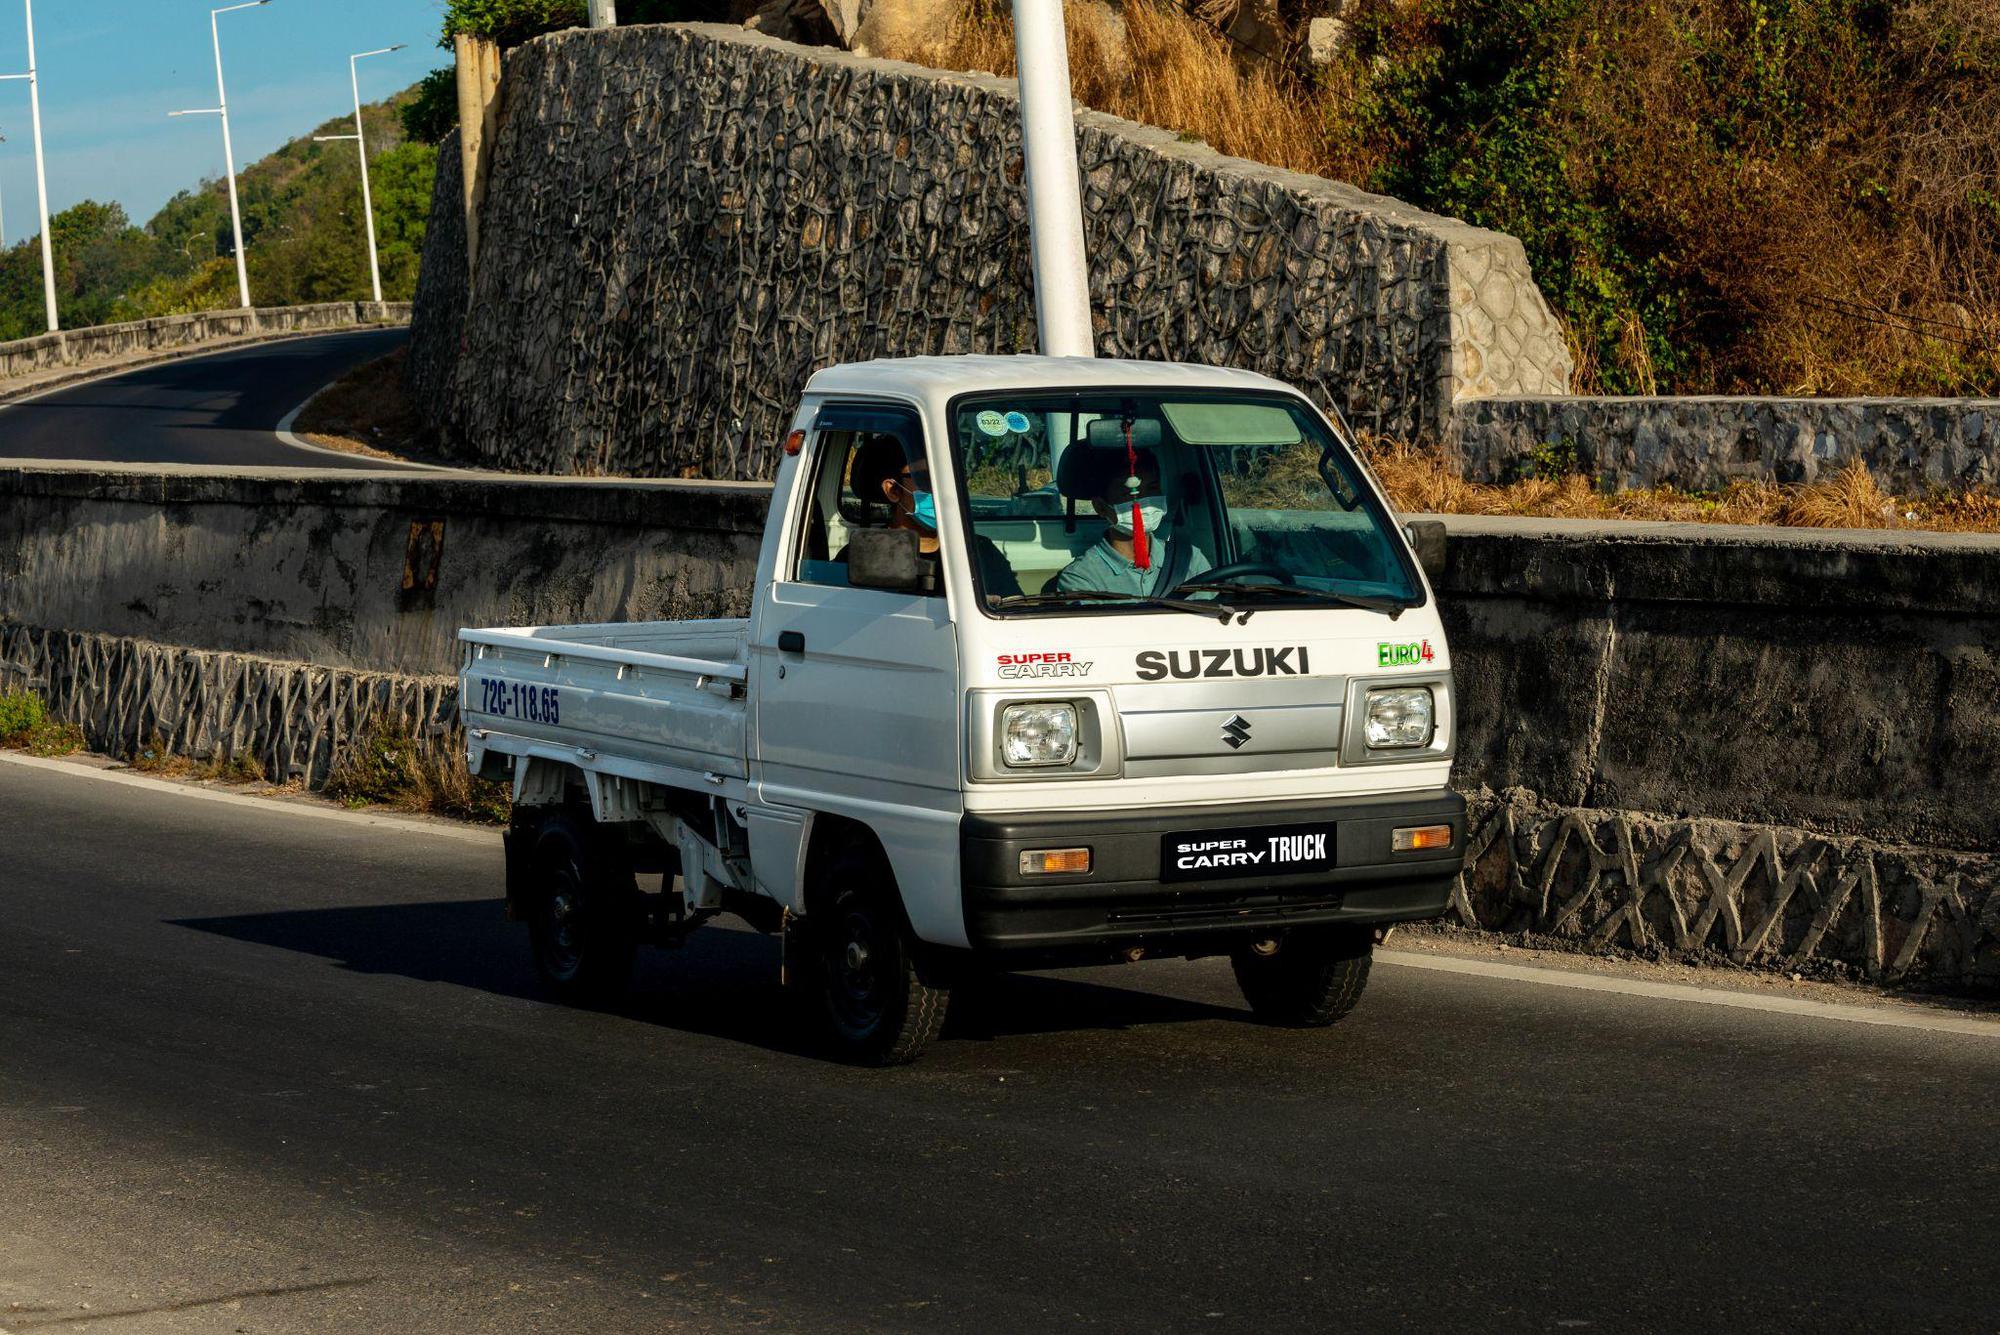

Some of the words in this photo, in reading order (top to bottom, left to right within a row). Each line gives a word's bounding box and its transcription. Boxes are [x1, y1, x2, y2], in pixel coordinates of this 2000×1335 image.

[997, 652, 1071, 665] SUPER
[1135, 646, 1310, 681] SUZUKI
[998, 662, 1094, 679] CARRY
[481, 678, 560, 725] 72C-118.65
[1177, 839, 1247, 853] SUPER
[1268, 833, 1327, 863] TRUCK
[1177, 851, 1266, 869] CARRY
